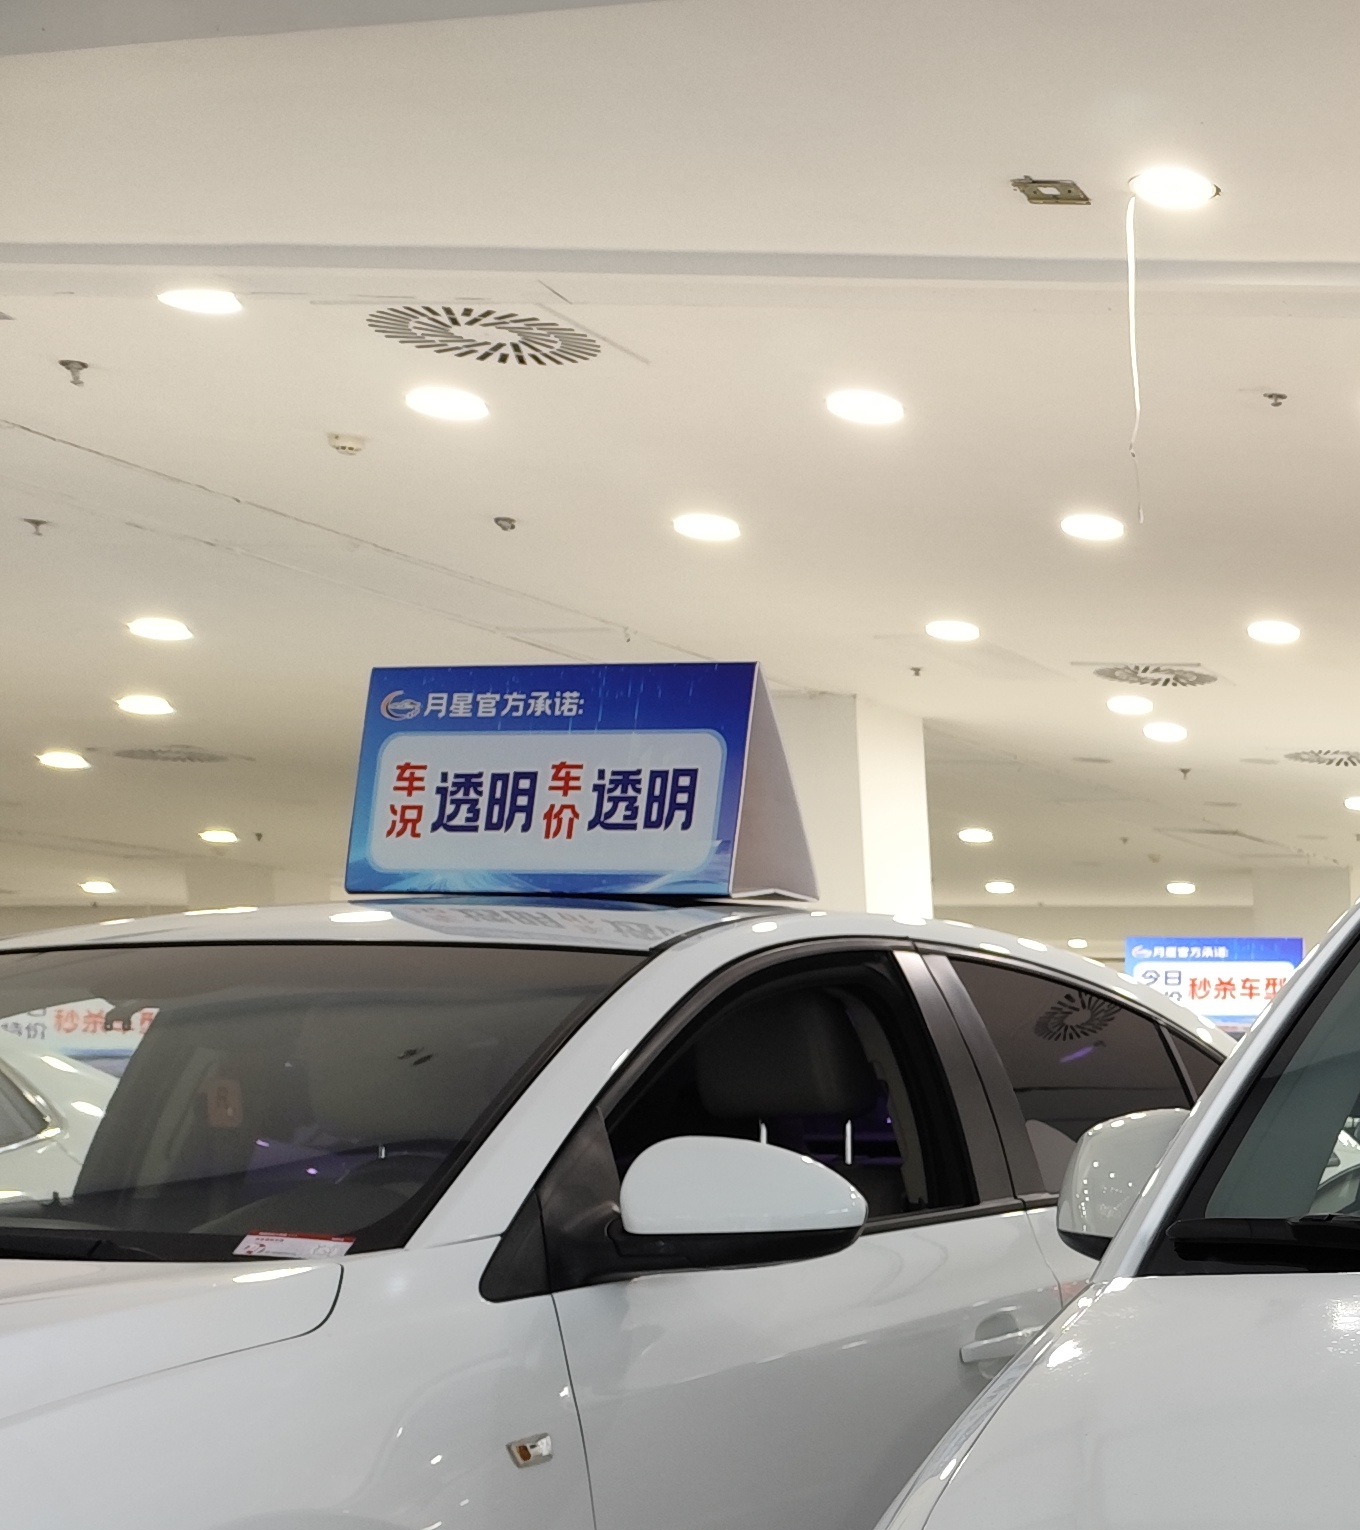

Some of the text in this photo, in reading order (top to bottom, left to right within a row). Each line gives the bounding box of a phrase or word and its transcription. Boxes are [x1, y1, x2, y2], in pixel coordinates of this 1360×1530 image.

[423, 690, 585, 719] 月星官方承诺:
[430, 770, 539, 833] 透明
[587, 767, 699, 832] 透明
[1141, 970, 1182, 986] 今日
[1188, 977, 1287, 1000] 秒杀车型
